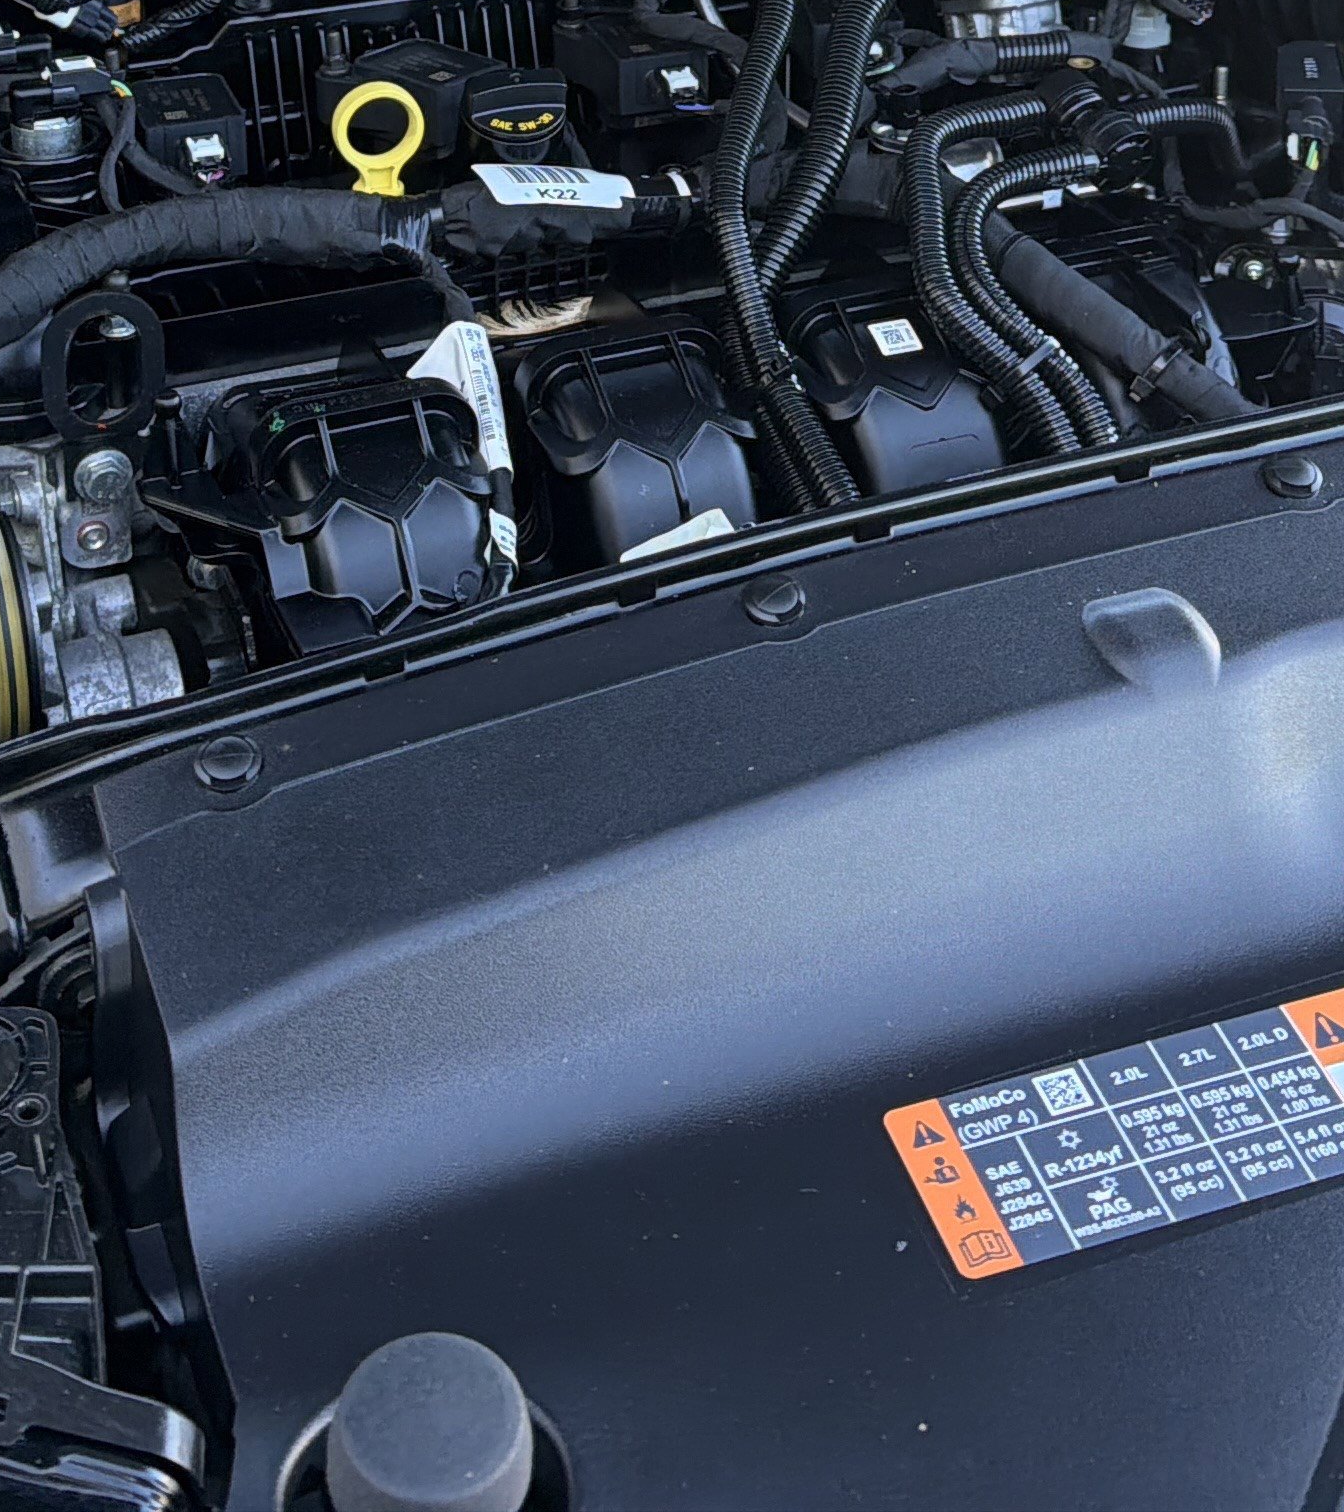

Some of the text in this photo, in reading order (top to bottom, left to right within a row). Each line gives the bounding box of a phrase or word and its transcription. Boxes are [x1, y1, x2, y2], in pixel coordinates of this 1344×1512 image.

[490, 112, 555, 132] SAE 5W-30
[535, 188, 582, 201] K22
[1237, 1027, 1289, 1051] 2.0L D
[1178, 1047, 1217, 1067] 2.7L
[1109, 1065, 1149, 1086] 2.0L
[1257, 1064, 1321, 1091] 0.454 kg
[1188, 1082, 1255, 1109] 0.595 kg
[1280, 1083, 1316, 1099] 16 oz
[948, 1088, 1027, 1119] FoMoCo
[1120, 1100, 1186, 1129] 0.595 kg
[1212, 1101, 1249, 1119] 21 oz
[1281, 1094, 1331, 1116] 1.00 lbs
[957, 1107, 1039, 1144] (GWP 4)
[1142, 1120, 1181, 1138] 21 oz
[1213, 1113, 1264, 1135] 1.31 lbs
[1293, 1125, 1319, 1146] 5.4
[1319, 1123, 1333, 1139] fl
[1143, 1131, 1195, 1154] 1.31 lbs
[1224, 1139, 1287, 1164] 3.2 fl oz
[1304, 1141, 1339, 1163] (160
[984, 1160, 1023, 1181] SAE
[1044, 1144, 1124, 1179] R-1234yf
[1154, 1159, 1218, 1184] 3.2 fl oz
[1240, 1155, 1295, 1181] (95 cc)
[994, 1177, 1032, 1198] J639
[1170, 1174, 1225, 1202] (95 cc)
[1000, 1192, 1046, 1215] J2842
[1088, 1196, 1133, 1221] PAG
[1008, 1208, 1054, 1232] J2845
